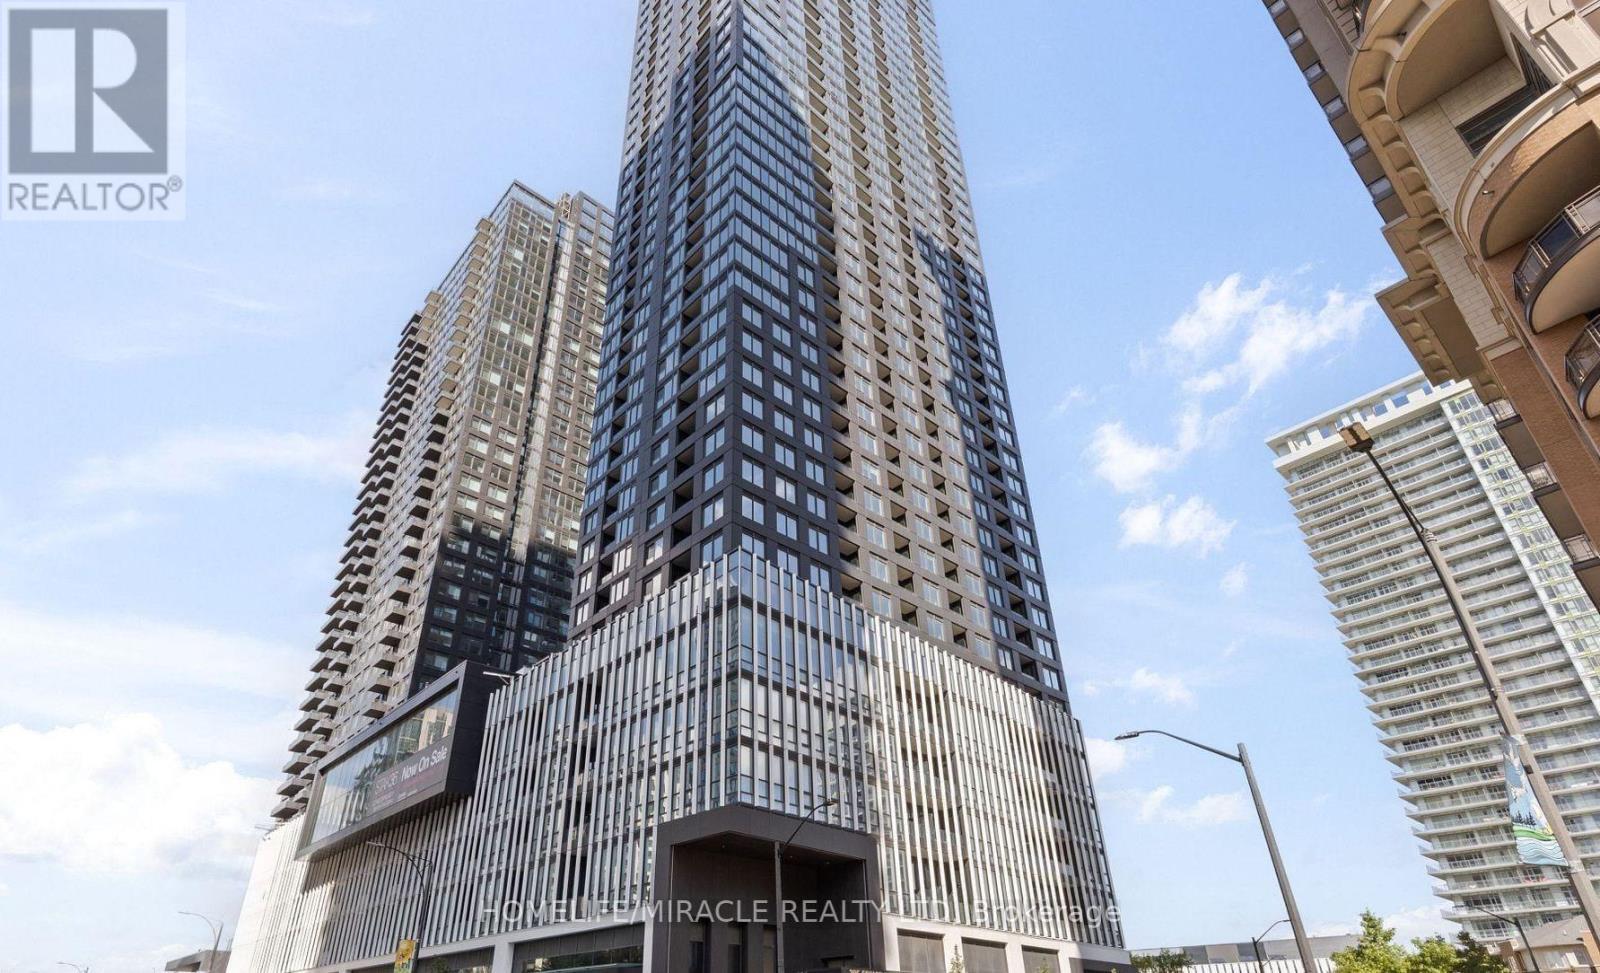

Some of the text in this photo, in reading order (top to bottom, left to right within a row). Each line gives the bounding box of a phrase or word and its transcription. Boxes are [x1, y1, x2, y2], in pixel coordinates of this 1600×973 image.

[401, 764, 418, 782] Now
[418, 756, 430, 772] On
[430, 745, 448, 766] Sale
